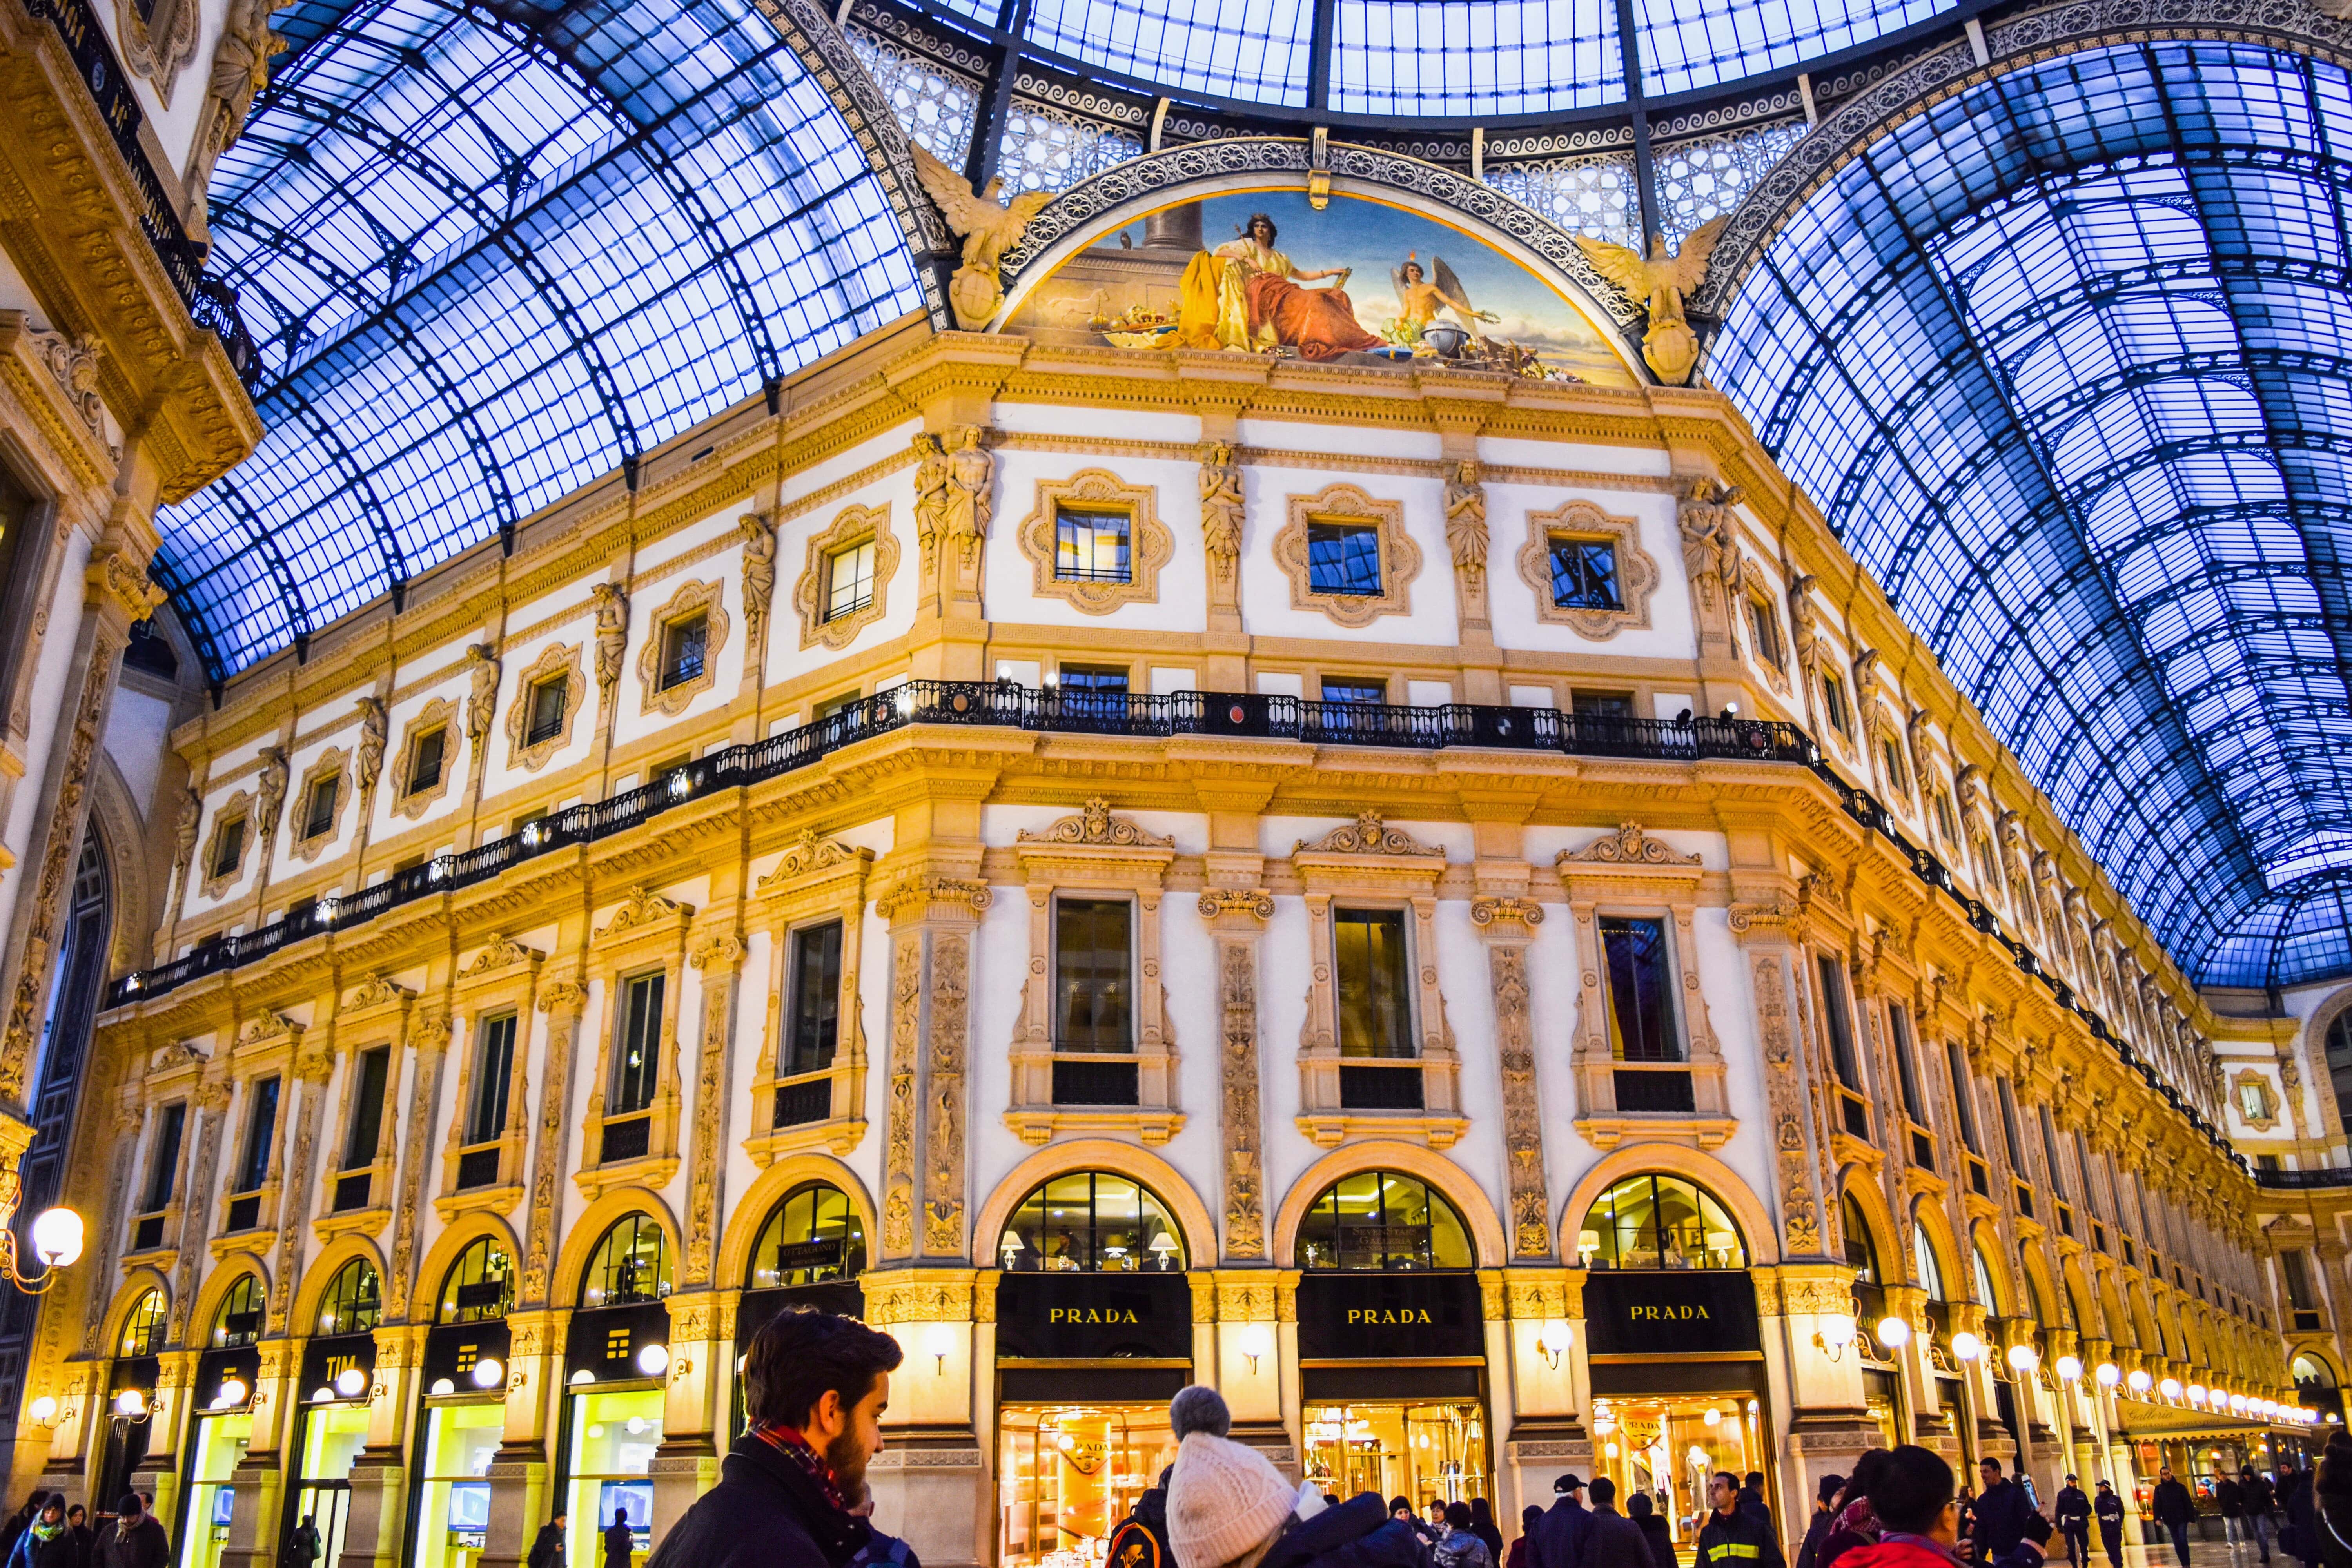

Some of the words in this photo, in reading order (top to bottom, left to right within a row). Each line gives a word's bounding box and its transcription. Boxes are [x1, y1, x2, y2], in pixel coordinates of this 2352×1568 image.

[783, 1243, 836, 1256] OTTAGONO
[1050, 1308, 1138, 1323] PRADA
[1348, 1309, 1432, 1324] PRADA
[1631, 1305, 1710, 1320] PRADA
[326, 1355, 356, 1381] TIM
[2127, 1408, 2173, 1421] Galleria
[1625, 1421, 1661, 1430] PRADA
